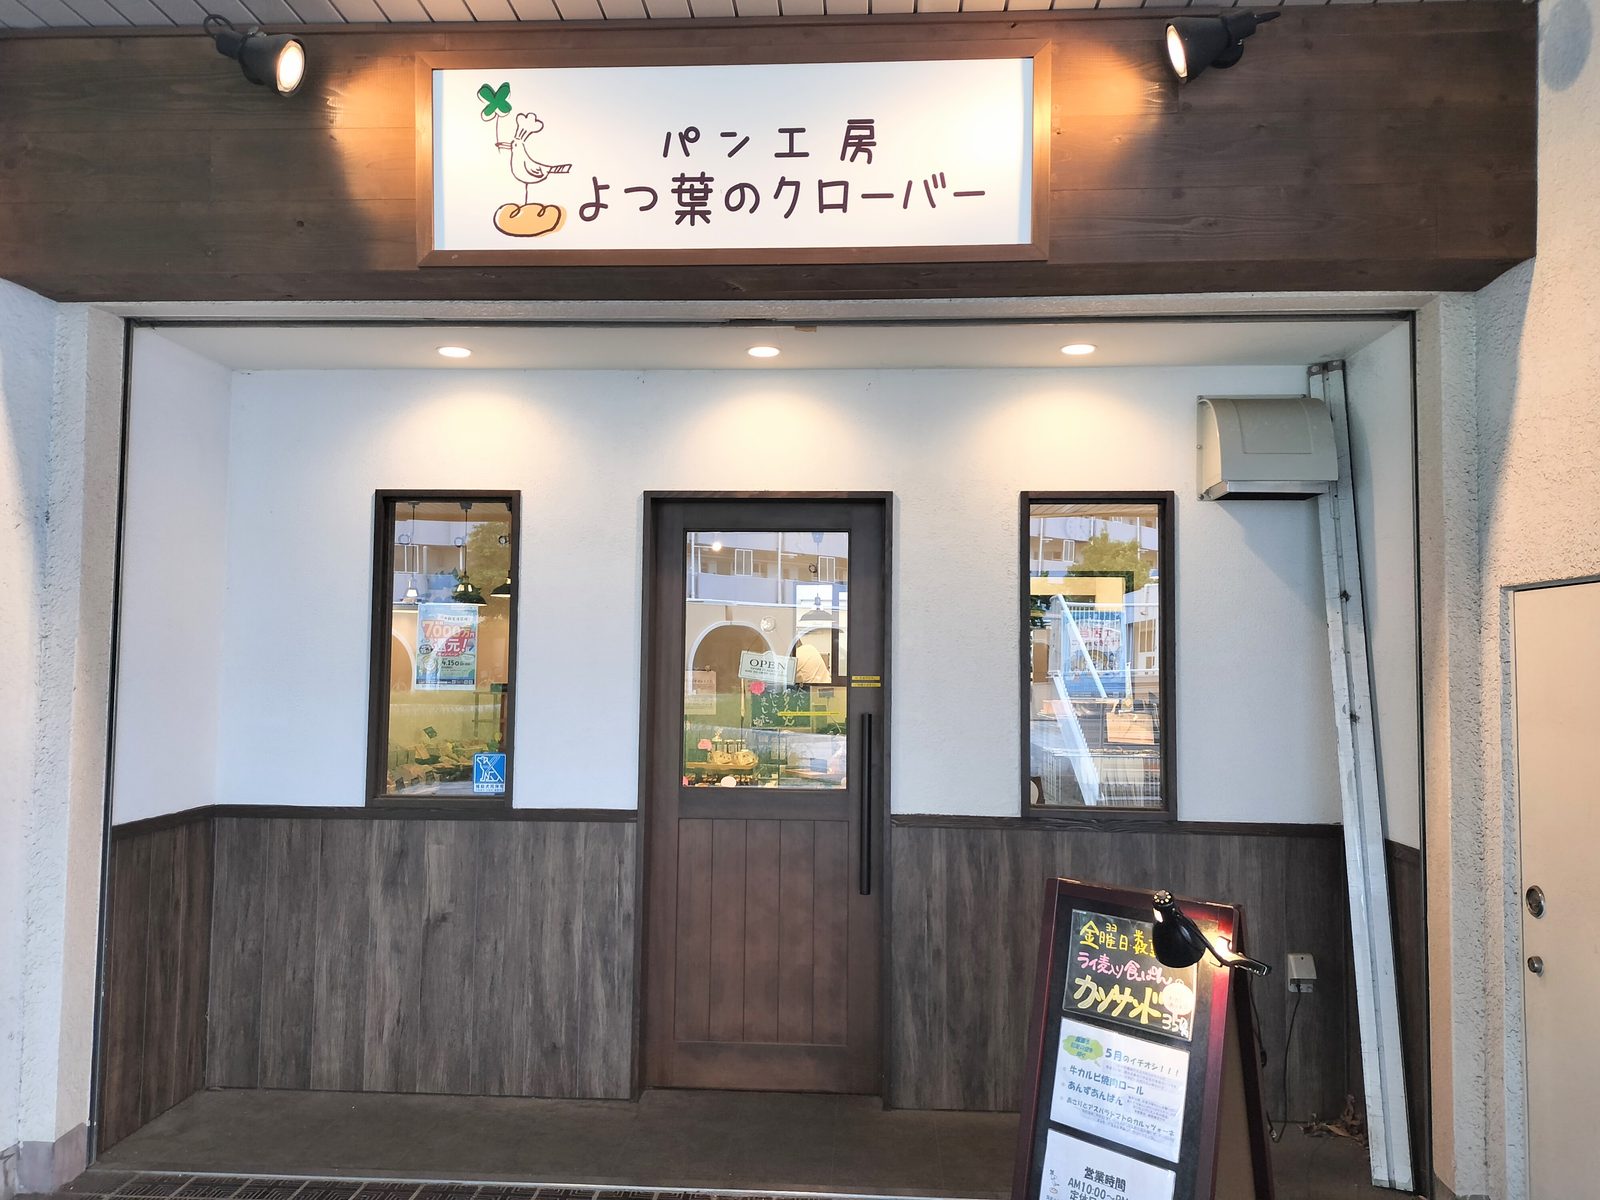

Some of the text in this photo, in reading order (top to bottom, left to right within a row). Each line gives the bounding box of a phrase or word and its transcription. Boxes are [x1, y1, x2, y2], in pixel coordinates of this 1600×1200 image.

[663, 119, 877, 164] パン工房
[749, 658, 786, 670] OPEN
[1084, 1166, 1127, 1192] 営業時間
